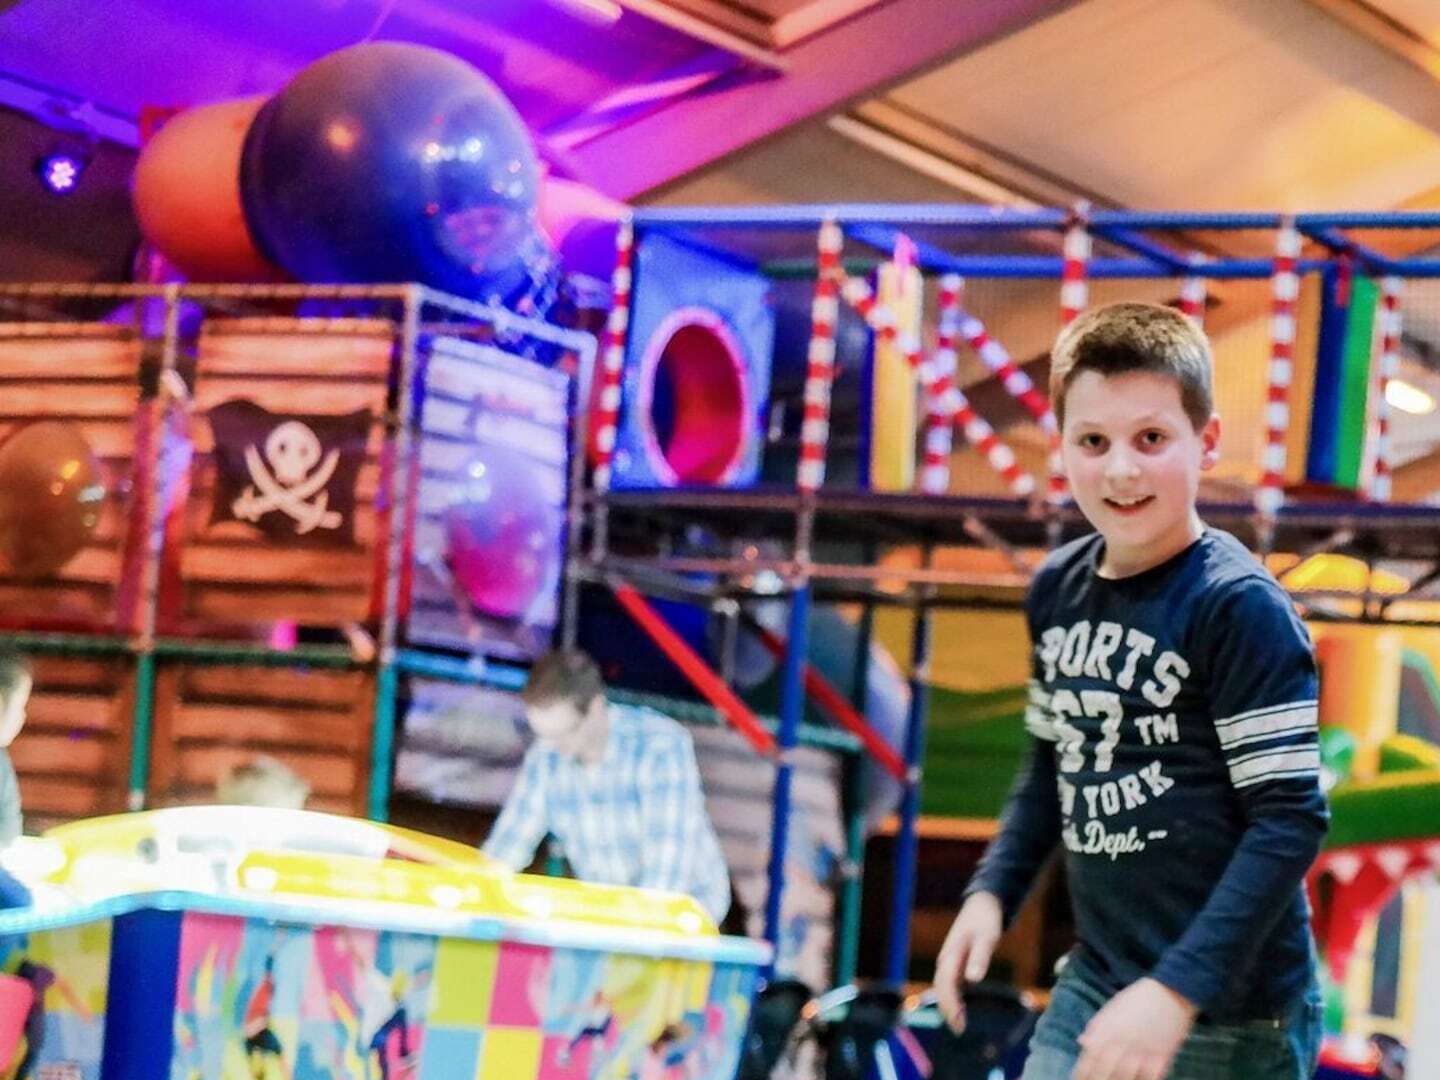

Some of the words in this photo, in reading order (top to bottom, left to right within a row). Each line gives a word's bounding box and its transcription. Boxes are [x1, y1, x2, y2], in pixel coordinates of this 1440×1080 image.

[1036, 619, 1191, 708] PORTS
[1134, 713, 1180, 745] TM
[1082, 760, 1175, 819] YORK
